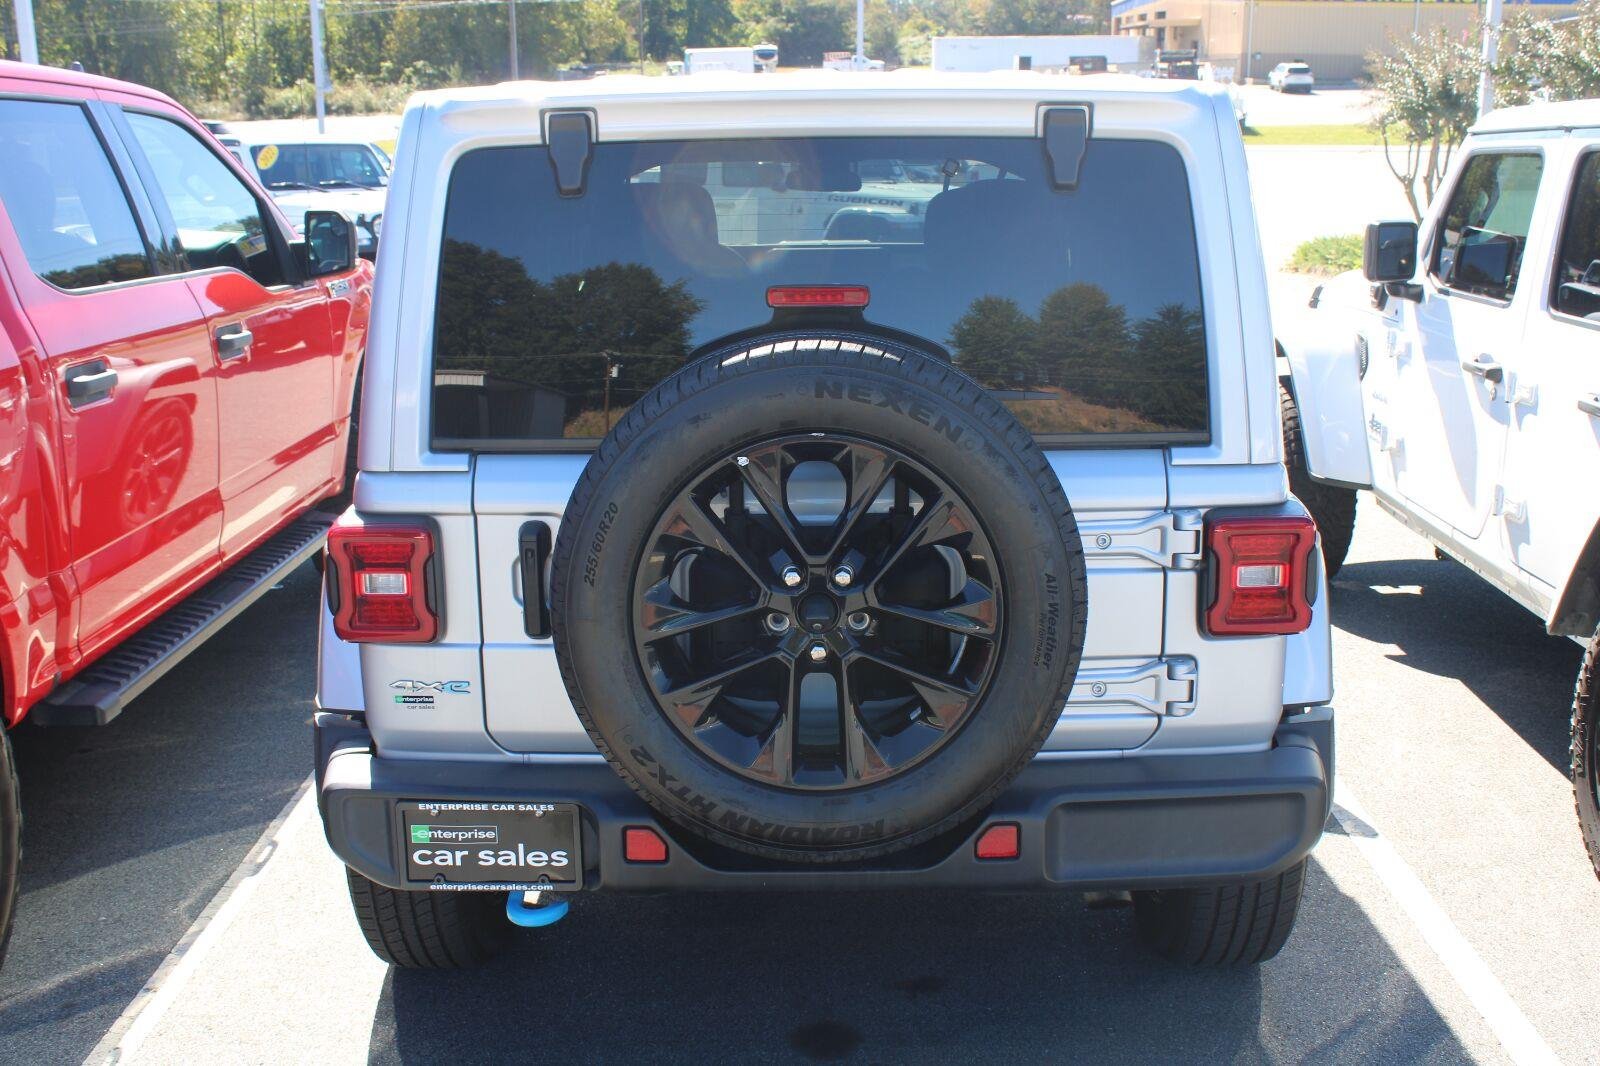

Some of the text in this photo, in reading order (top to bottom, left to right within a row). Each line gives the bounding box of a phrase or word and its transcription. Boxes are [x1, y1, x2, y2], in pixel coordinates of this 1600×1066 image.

[829, 193, 903, 207] RUBICON
[814, 377, 964, 444] NEXEN
[584, 502, 618, 588] 255/60R20
[418, 803, 555, 812] ENTERPRISE CAR SALES
[413, 828, 496, 841] enterprise
[719, 809, 885, 841] ROADIAN
[412, 843, 569, 867] car sales
[430, 883, 553, 892] enterprisecarsales.com
